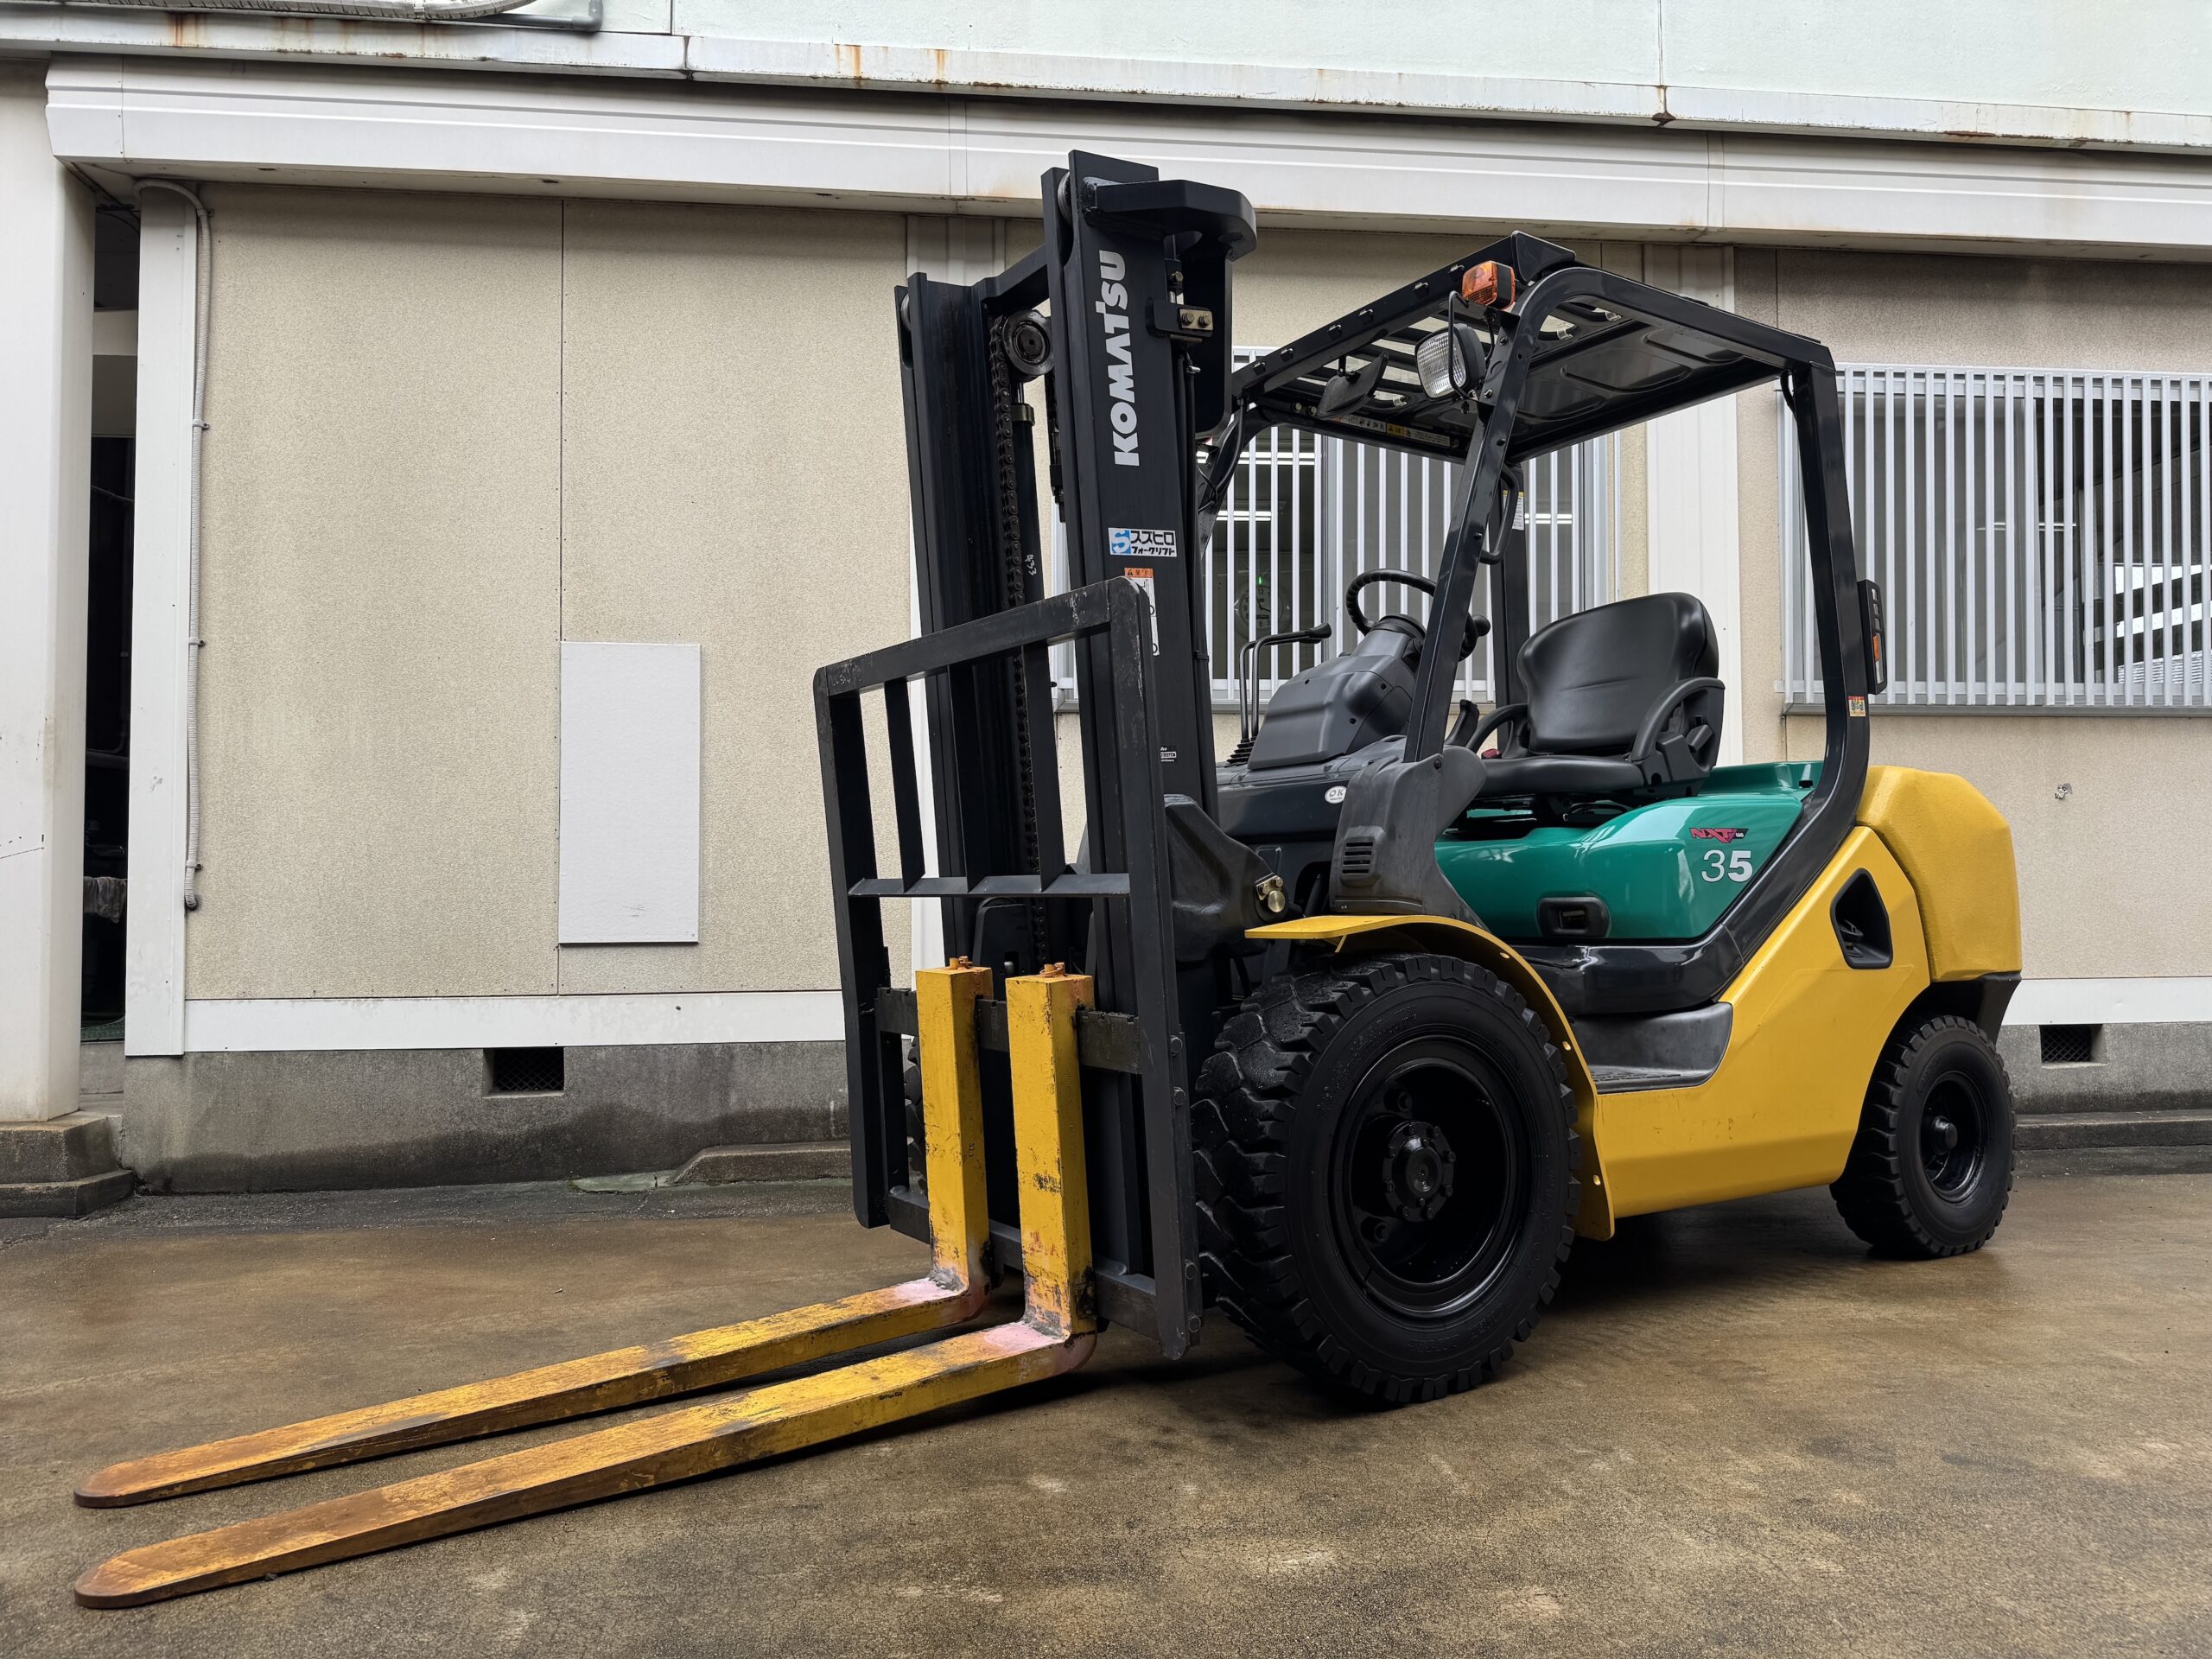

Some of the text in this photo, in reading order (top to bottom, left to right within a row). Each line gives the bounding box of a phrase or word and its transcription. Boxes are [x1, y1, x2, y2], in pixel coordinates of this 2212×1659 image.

[1096, 250, 1140, 467] KOMATSU
[1130, 531, 1175, 545] スズヒロ
[1131, 546, 1175, 556] フォークリフト
[1701, 849, 1753, 882] 35
